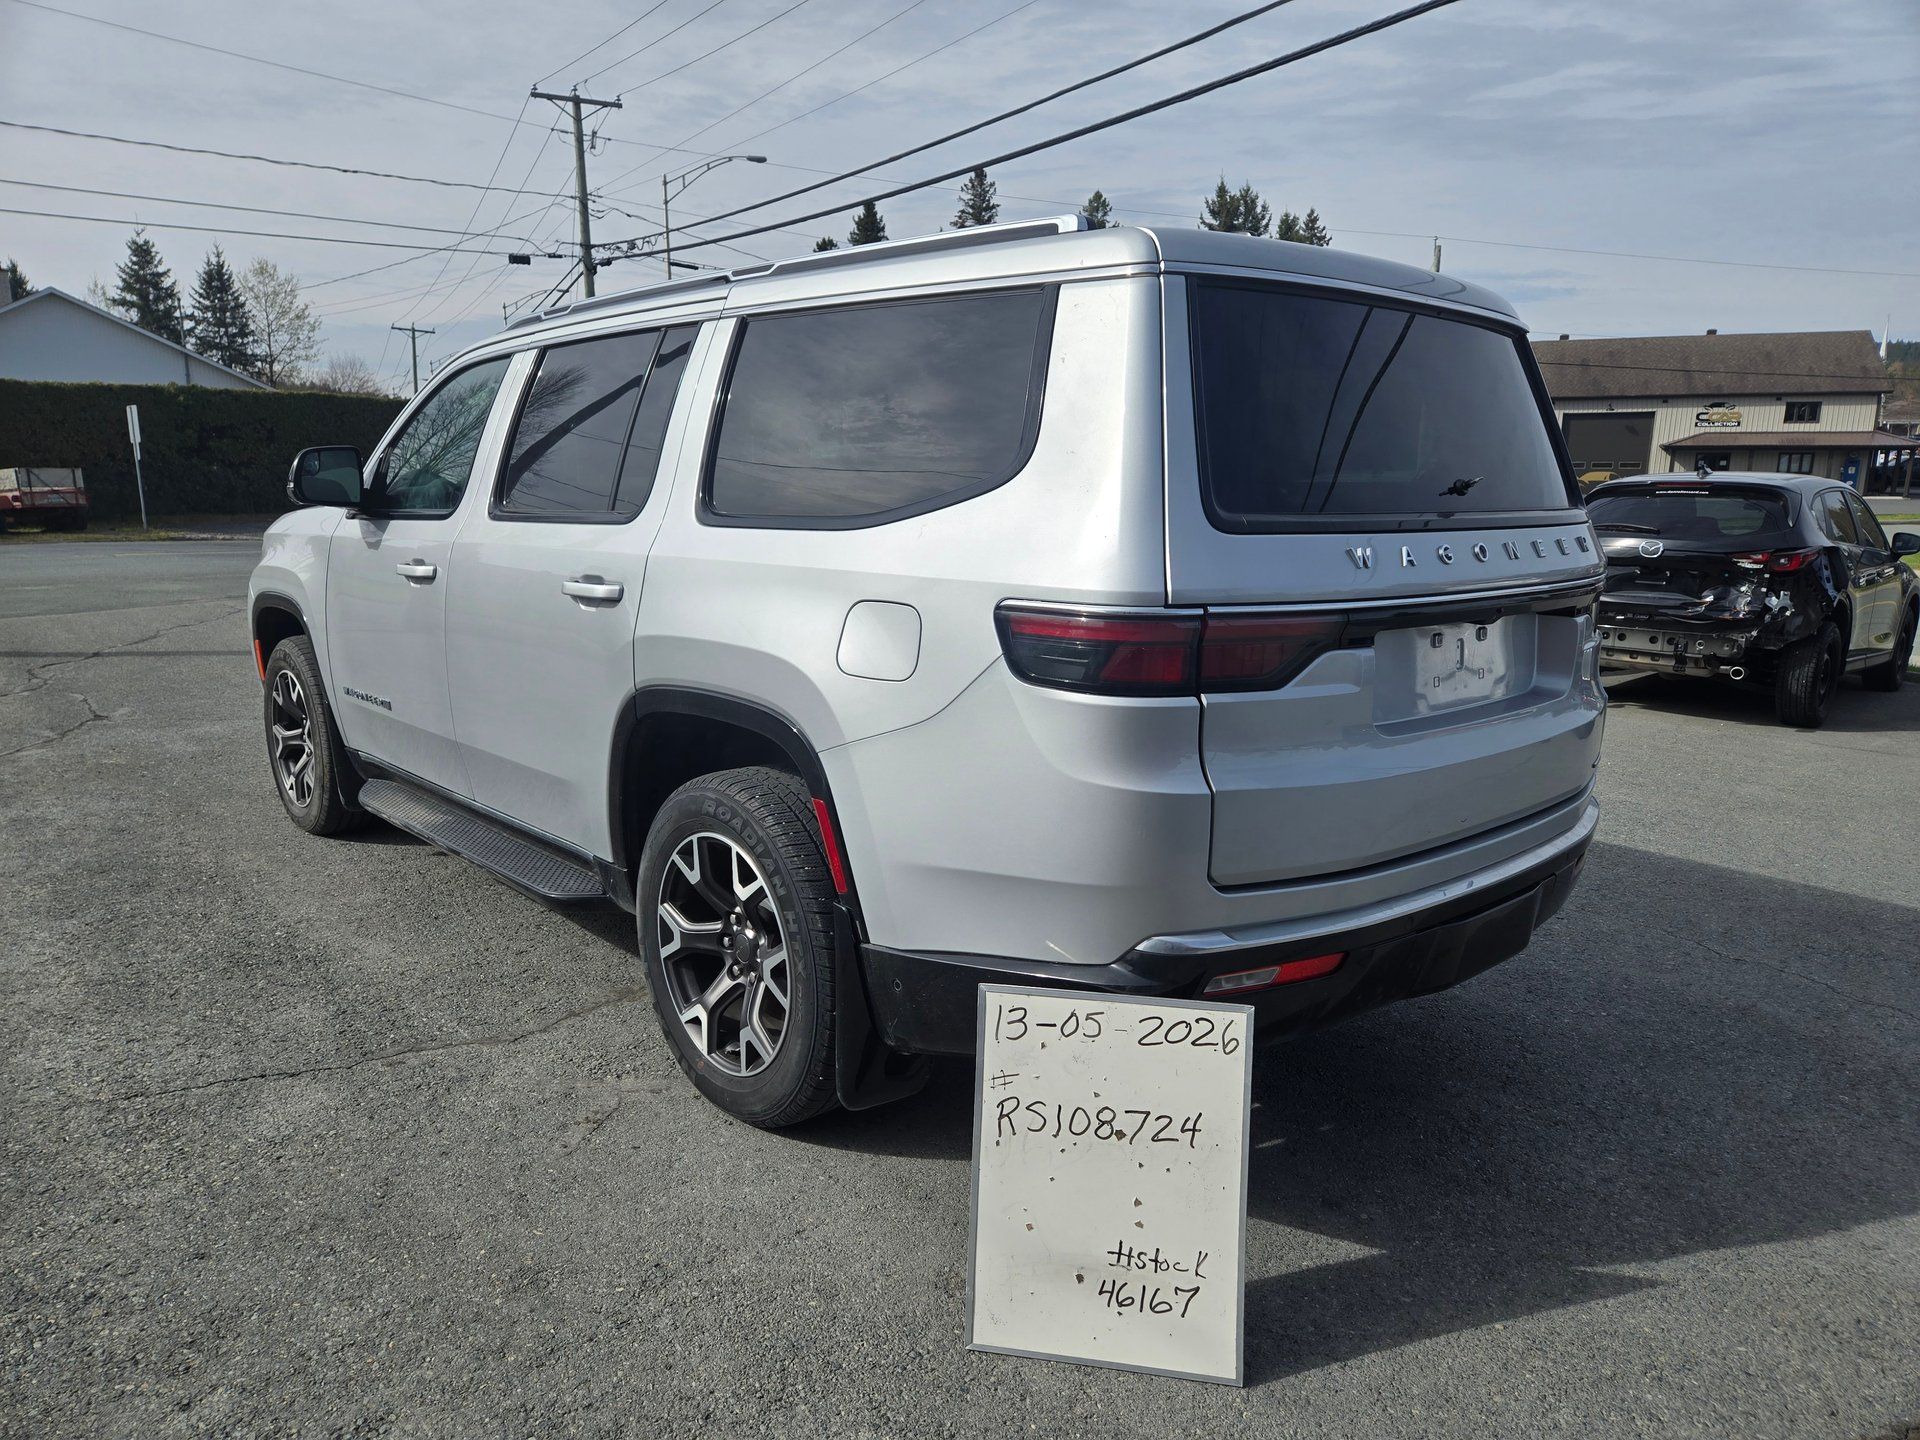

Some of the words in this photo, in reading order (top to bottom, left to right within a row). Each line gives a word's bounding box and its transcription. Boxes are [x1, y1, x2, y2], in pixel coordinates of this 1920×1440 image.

[1346, 536, 1590, 569] WAGONEER
[702, 799, 788, 897] ROADIAN
[997, 1096, 1203, 1149] RS108724
[1098, 1279, 1200, 1318] 46167
